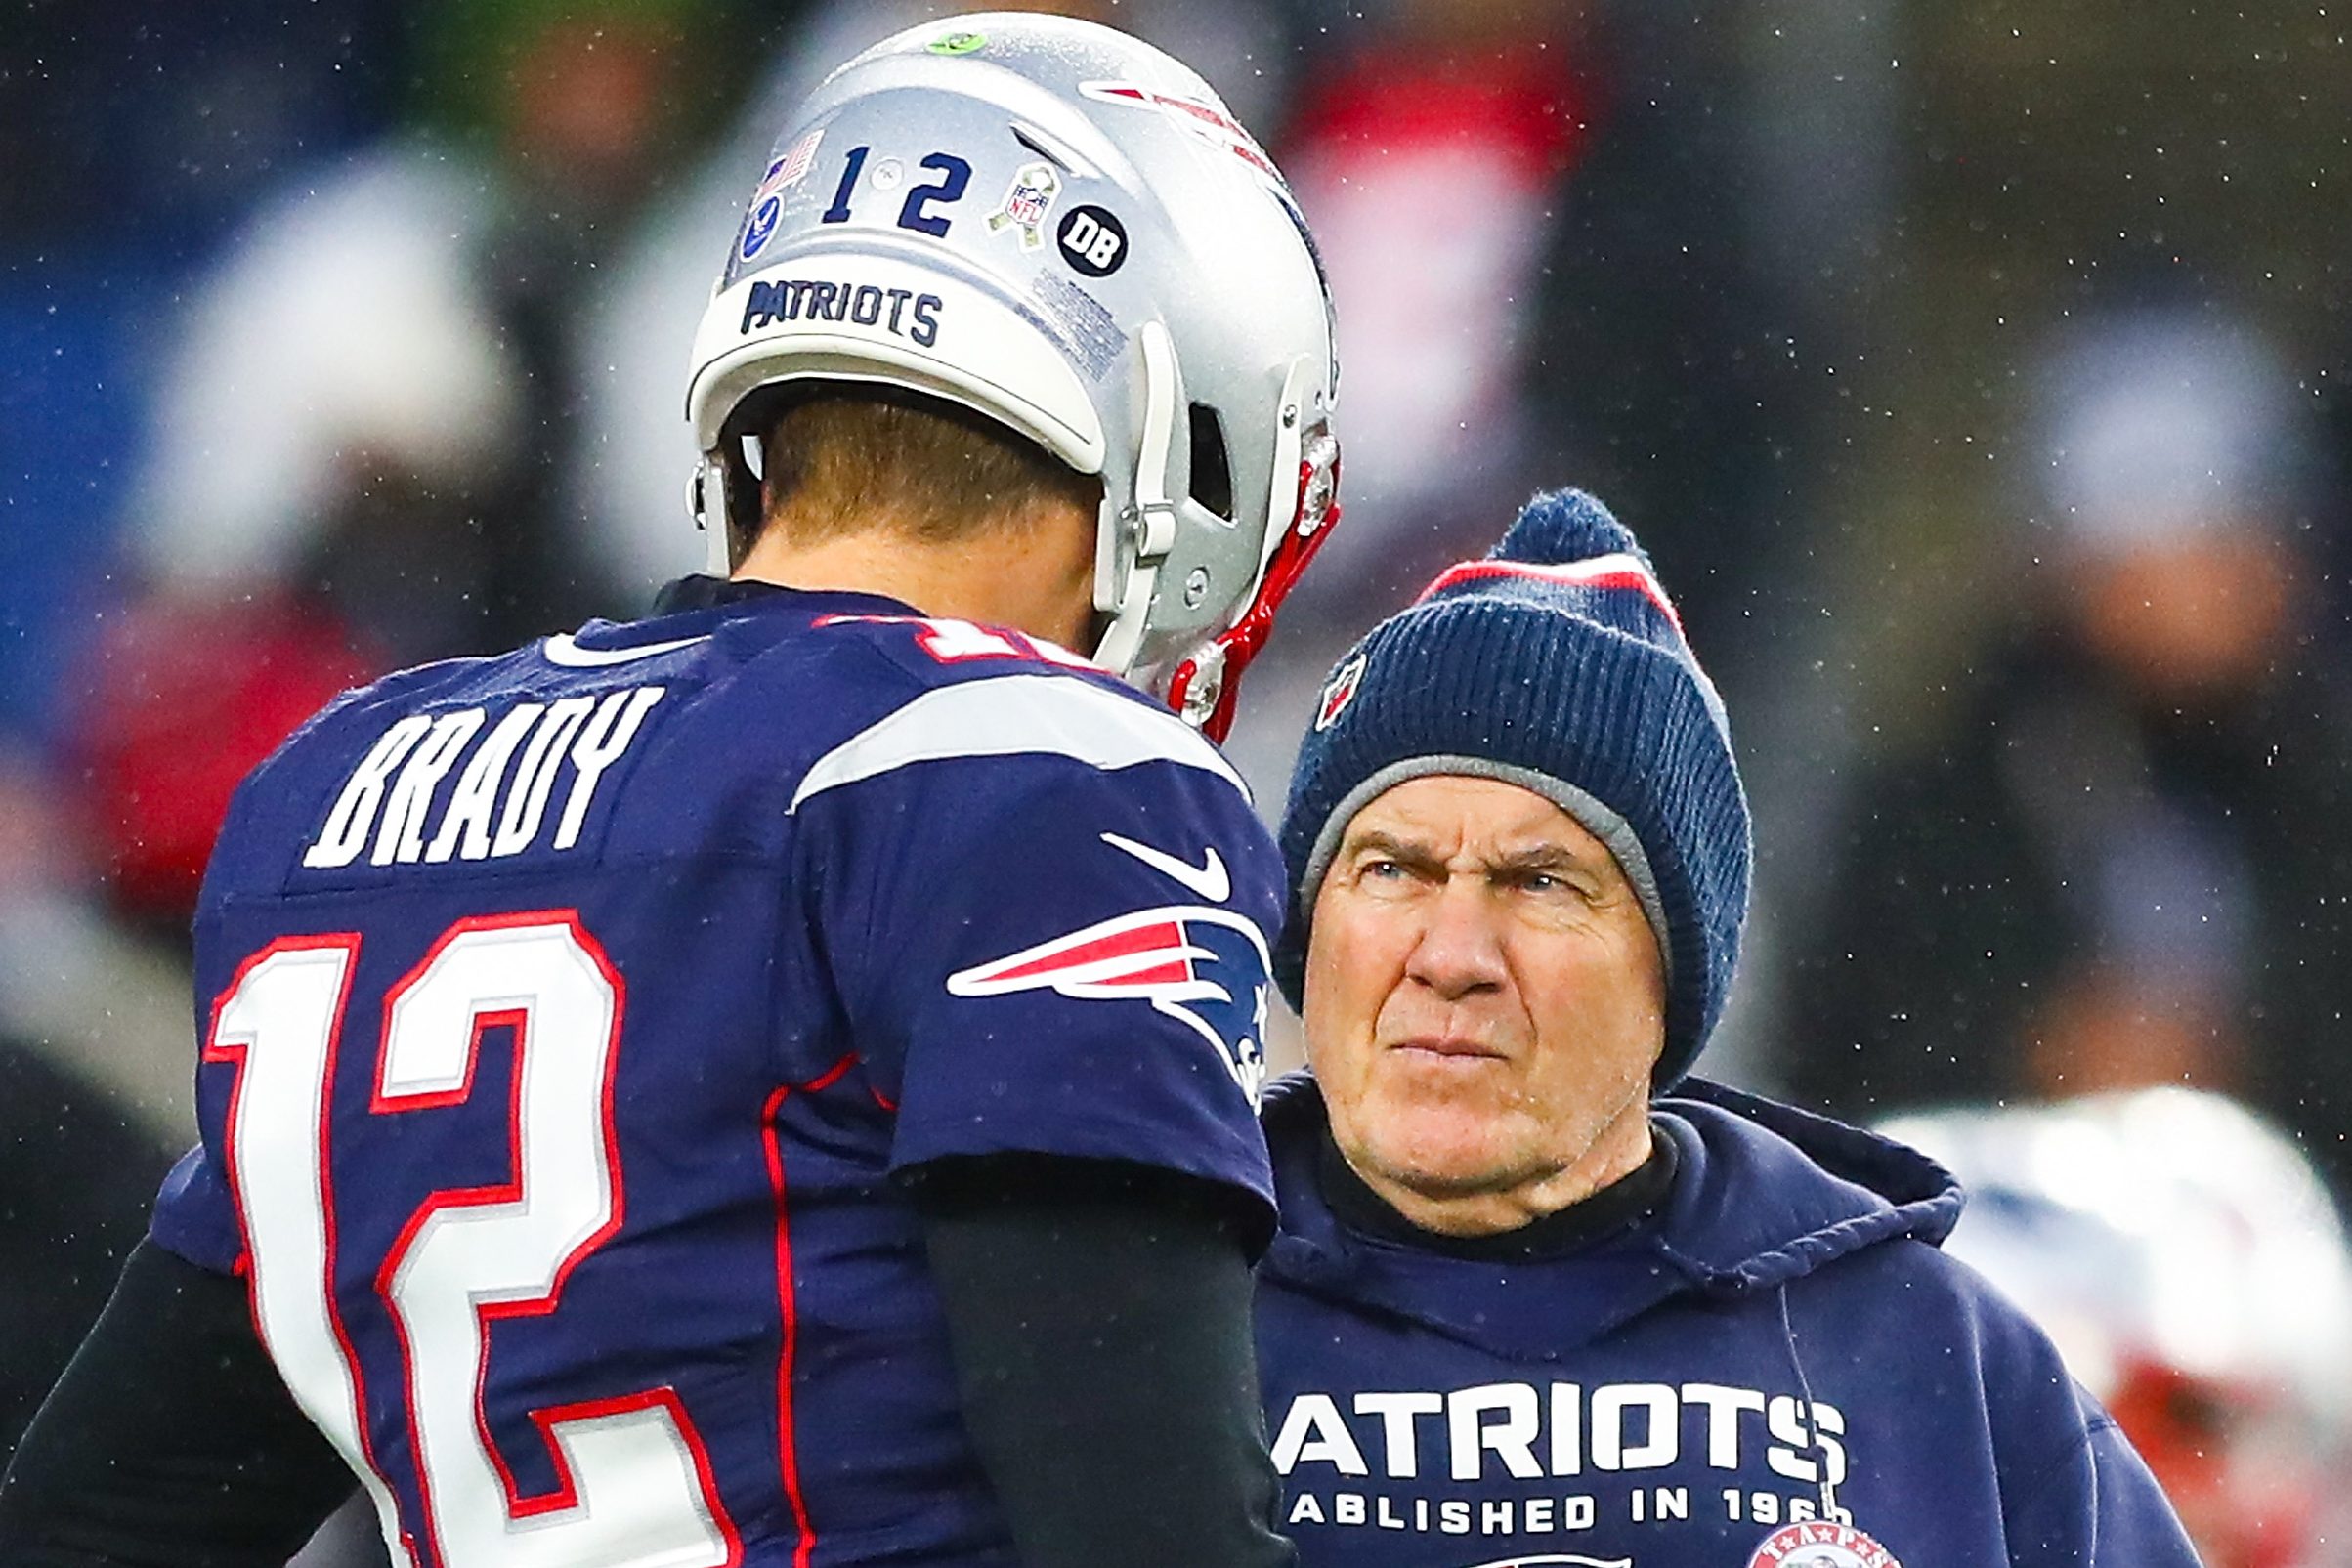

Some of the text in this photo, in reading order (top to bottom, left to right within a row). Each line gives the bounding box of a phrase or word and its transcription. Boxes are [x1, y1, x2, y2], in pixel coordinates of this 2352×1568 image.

[1008, 196, 1042, 224] NFL
[1062, 211, 1121, 269] DB
[740, 279, 944, 349] PATRIOTS
[303, 685, 666, 868] BRADY
[203, 907, 745, 1568] 12
[1289, 1494, 1595, 1534] ABLISHED
[1632, 1488, 1689, 1521] IN
